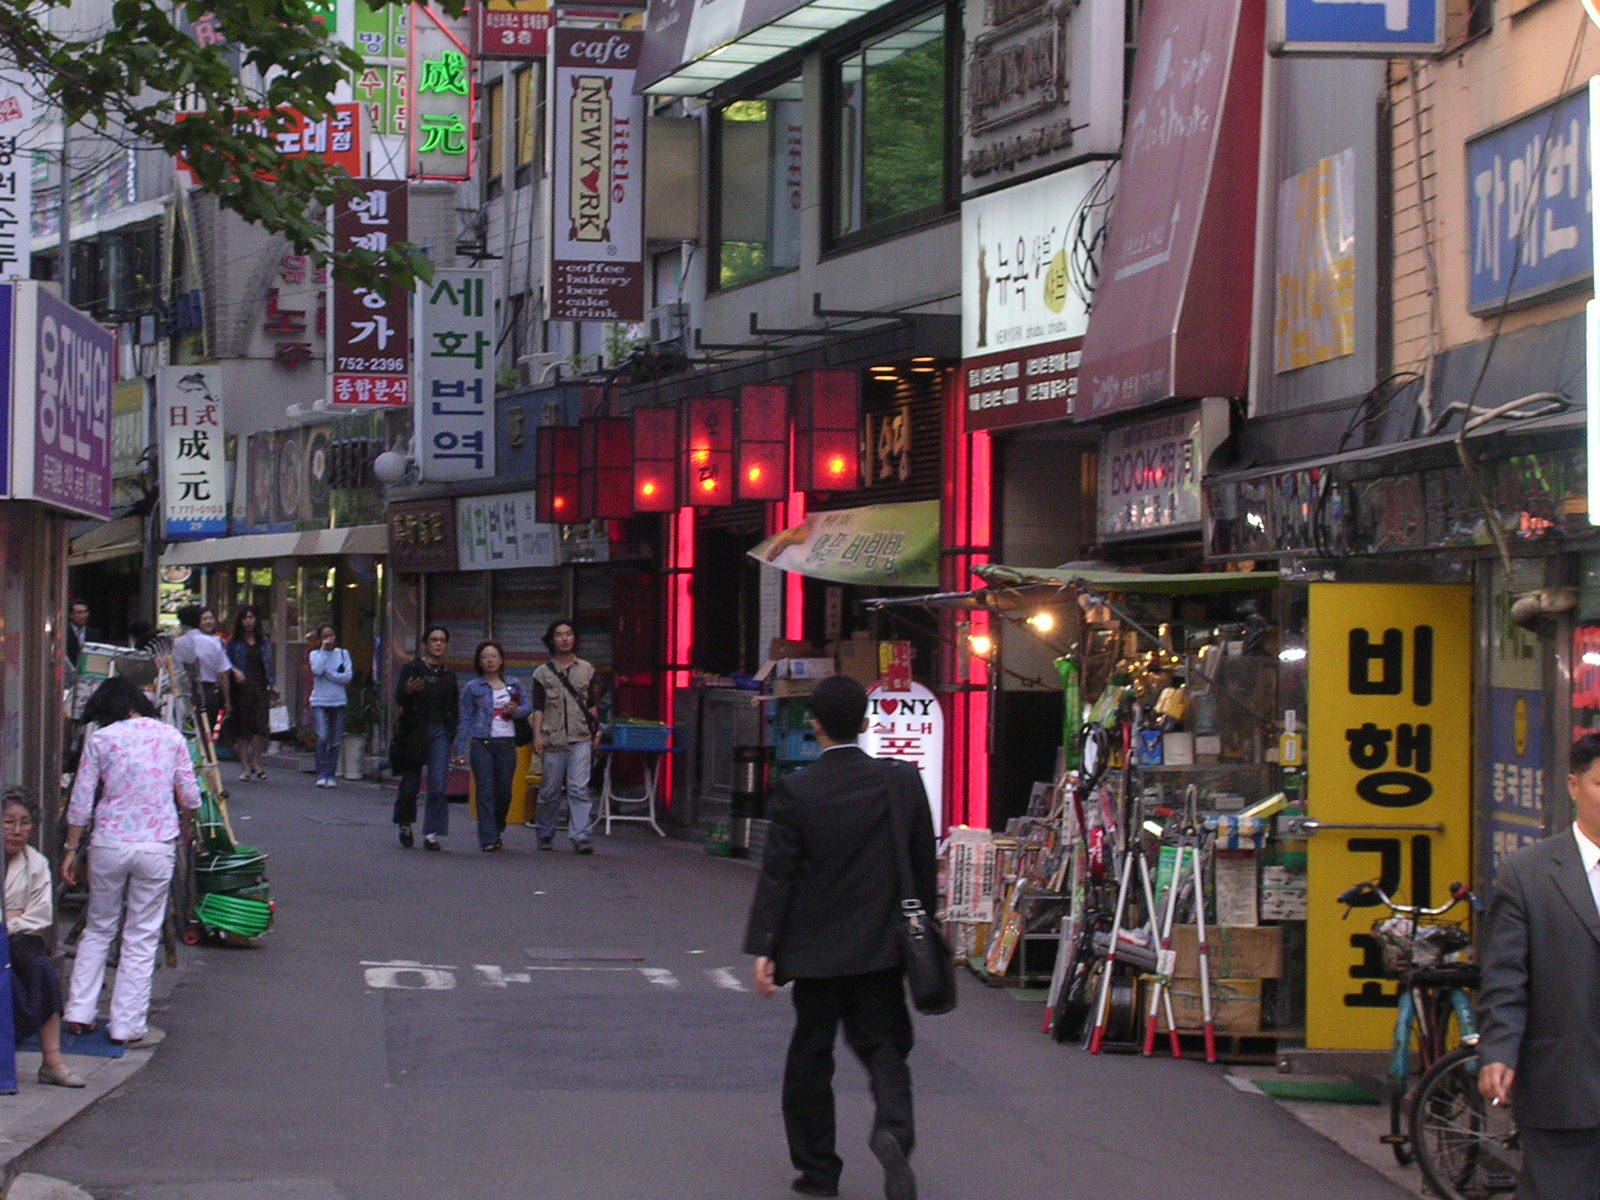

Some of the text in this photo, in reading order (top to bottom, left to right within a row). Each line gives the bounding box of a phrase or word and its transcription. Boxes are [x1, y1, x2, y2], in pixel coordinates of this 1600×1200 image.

[570, 35, 631, 65] cafe
[418, 50, 468, 154] 成元
[332, 111, 352, 152] 주점
[612, 117, 631, 204] little
[565, 263, 625, 273] coffee
[566, 274, 632, 287] bakery
[566, 285, 609, 296] beer
[565, 296, 610, 307] cake
[565, 307, 619, 318] drink
[337, 357, 404, 371] 752-2396
[429, 277, 492, 470] 세화번역
[335, 378, 407, 403] 종합분식
[170, 405, 219, 427] 日式
[176, 429, 212, 502] 成元
[871, 698, 935, 716] I NY
